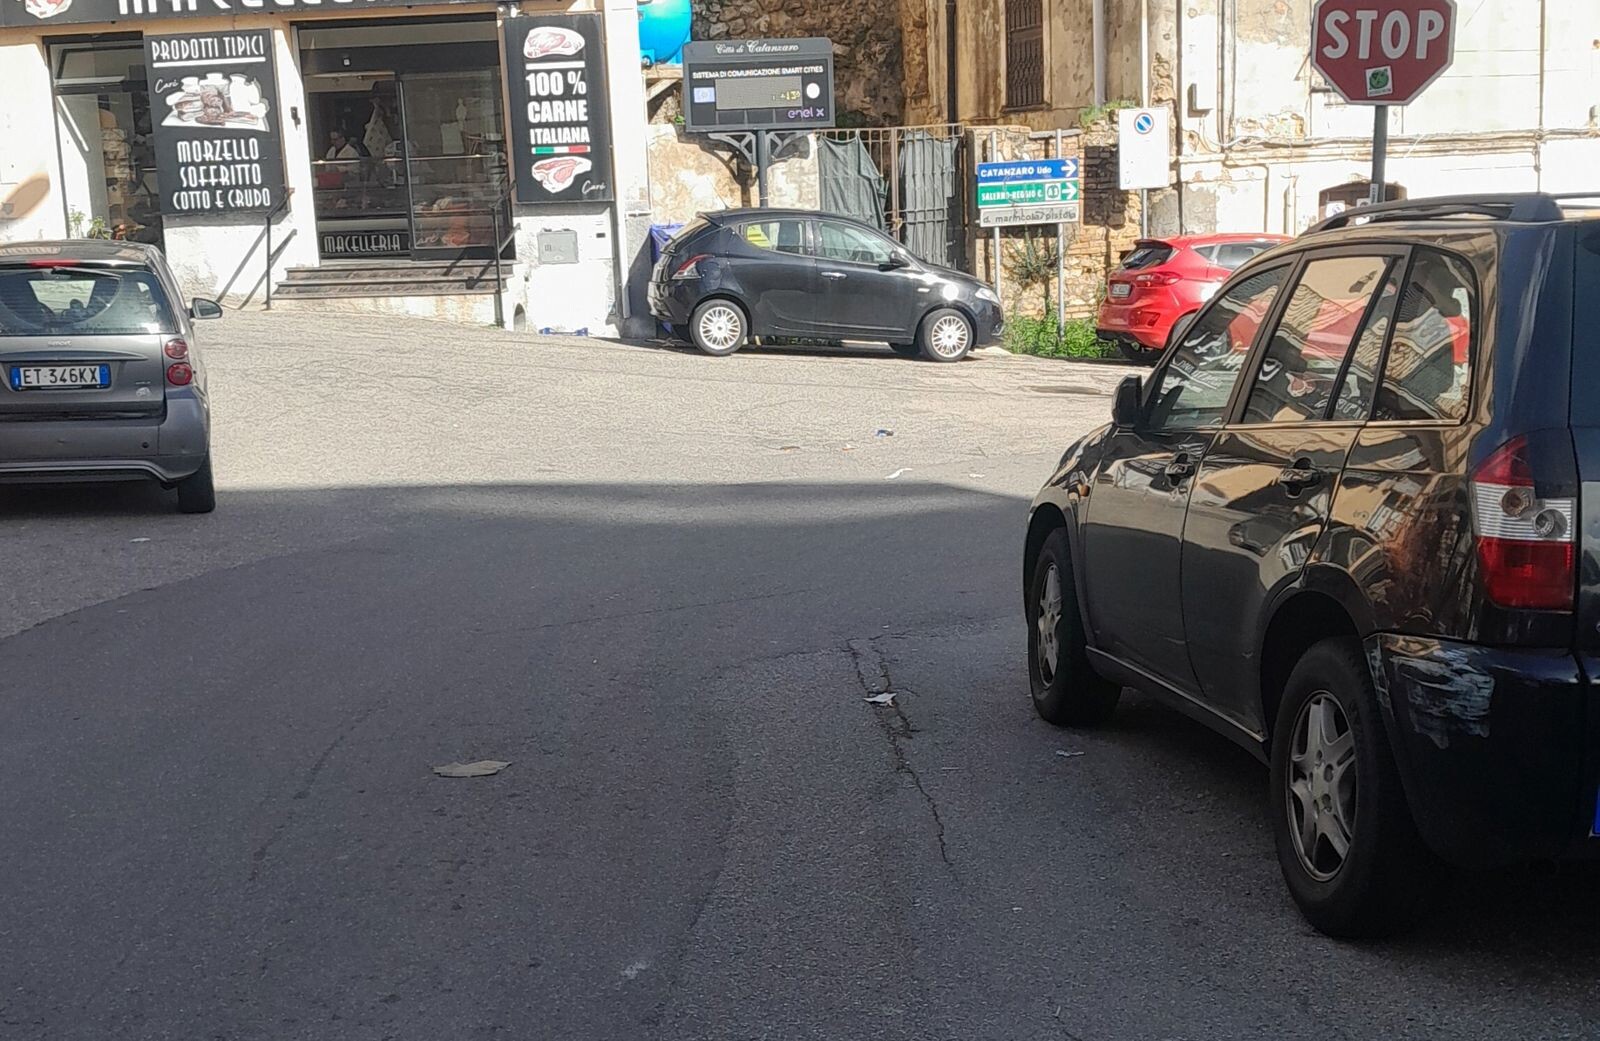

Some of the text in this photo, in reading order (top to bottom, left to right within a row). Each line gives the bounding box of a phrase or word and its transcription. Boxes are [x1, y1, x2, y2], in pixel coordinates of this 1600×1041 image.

[1322, 9, 1445, 60] STOP
[152, 35, 264, 60] PRODOTTI TIPICI
[736, 44, 744, 53] di
[746, 40, 799, 53] Catanzaro
[692, 71, 720, 79] SISTEMA
[727, 69, 781, 77] COMUNICAZIONE
[782, 67, 802, 75] SMART
[803, 65, 823, 73] CITIES
[526, 70, 587, 96] 100 %
[527, 100, 588, 123] CARNE
[788, 107, 813, 119] enel
[530, 127, 591, 144] ITALIANA
[177, 138, 259, 162] MORZELLO
[180, 163, 261, 187] SOFFRITTO
[980, 166, 1035, 178] CATANZARO
[173, 188, 271, 210] COTTO E CRUDO
[324, 235, 400, 252] MACELLERIA
[23, 367, 98, 385] ET 346KX
